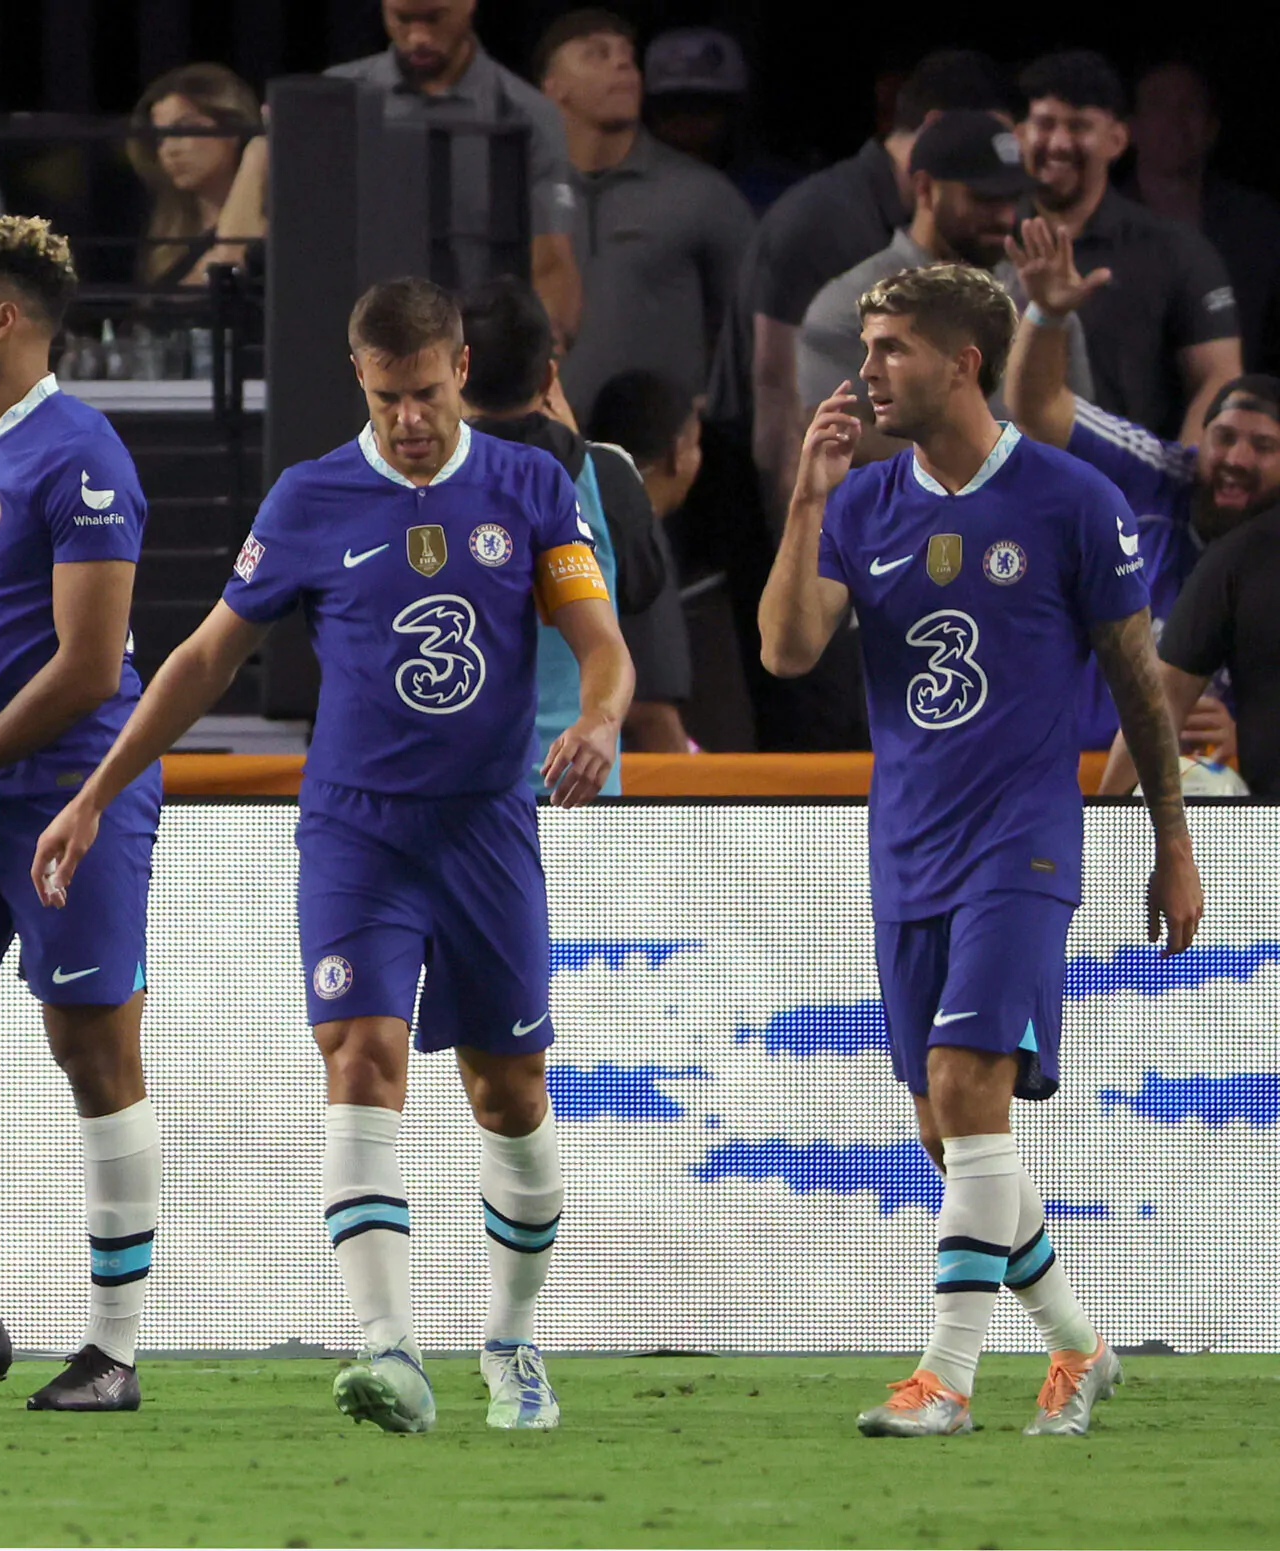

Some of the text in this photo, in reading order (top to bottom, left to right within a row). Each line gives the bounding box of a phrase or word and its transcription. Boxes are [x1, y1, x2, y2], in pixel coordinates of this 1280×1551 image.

[73, 513, 124, 526] WhaleFin
[392, 594, 486, 714] 3
[905, 609, 988, 730] 3
